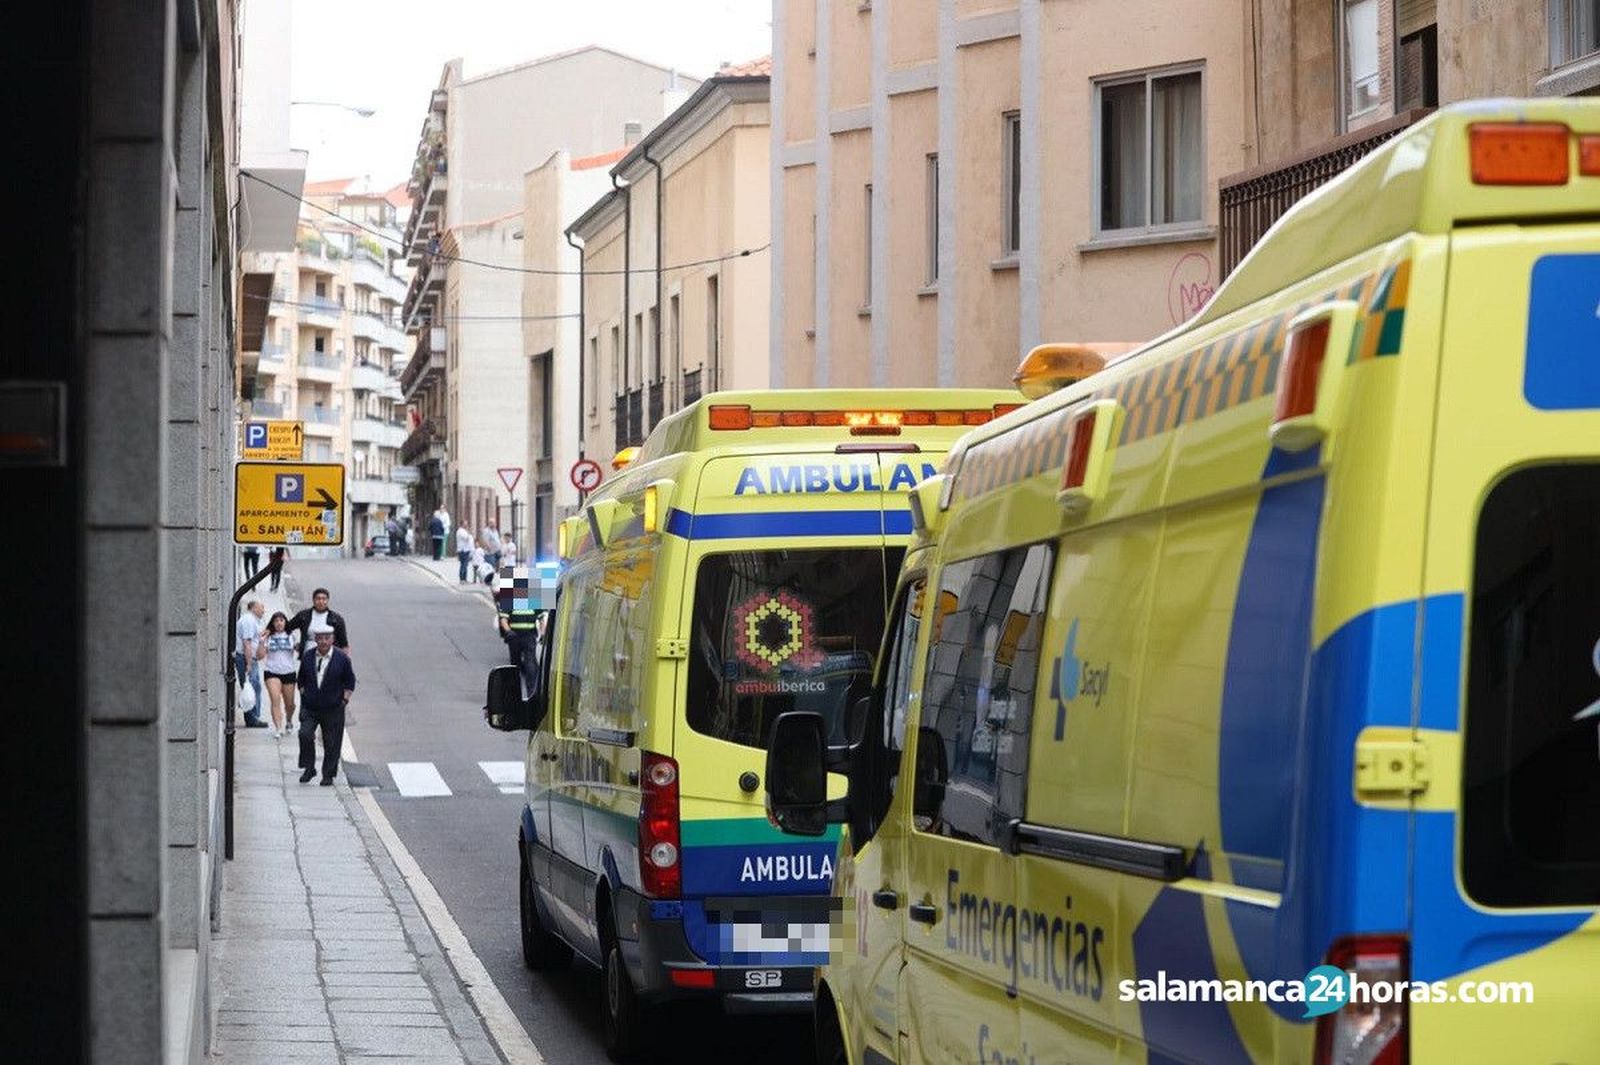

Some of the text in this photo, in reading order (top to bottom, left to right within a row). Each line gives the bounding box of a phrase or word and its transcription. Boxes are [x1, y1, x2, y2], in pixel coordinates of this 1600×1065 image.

[281, 477, 298, 498] P
[240, 510, 310, 518] APARCAMIENTO
[258, 525, 285, 535] SAN
[946, 868, 1104, 1002] Emergencias
[749, 972, 779, 986] SP
